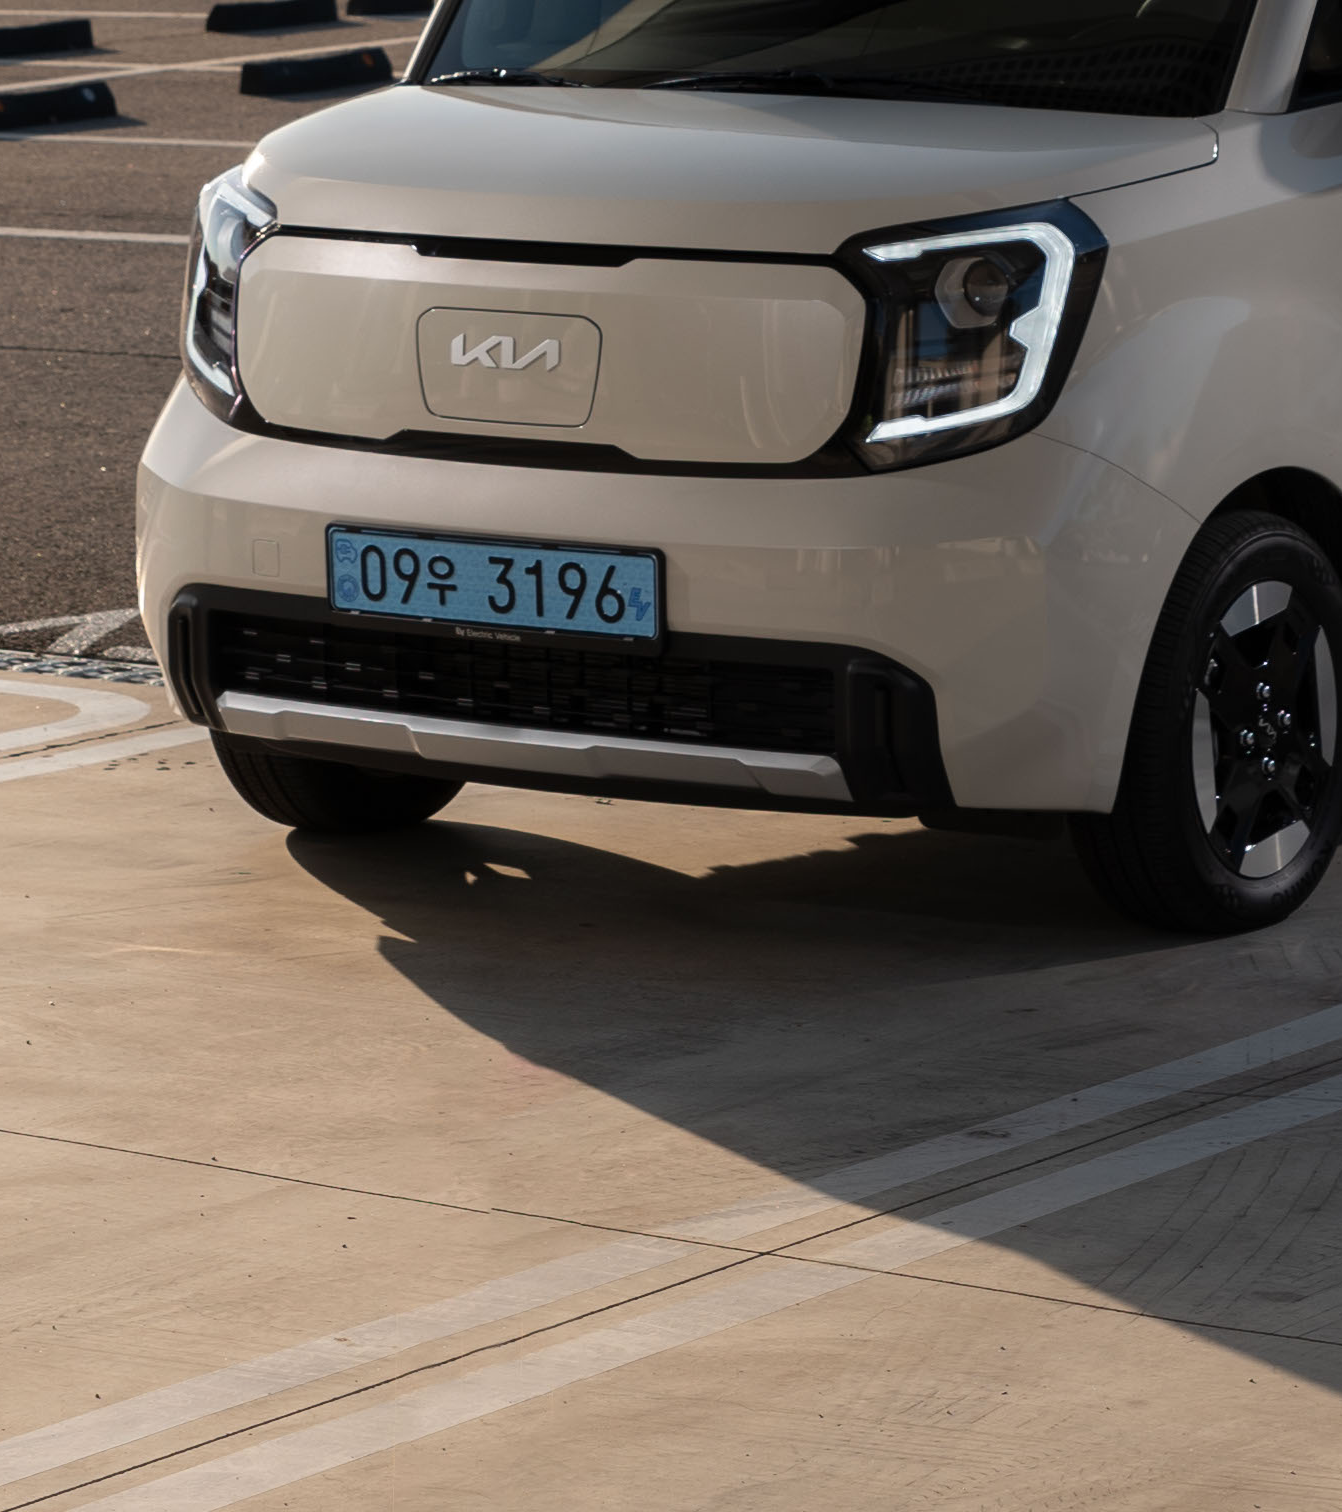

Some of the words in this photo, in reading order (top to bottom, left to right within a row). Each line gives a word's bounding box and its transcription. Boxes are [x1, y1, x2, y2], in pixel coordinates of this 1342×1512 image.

[450, 333, 561, 372] KIA
[360, 544, 457, 607] 09우
[488, 556, 626, 625] 3196
[628, 587, 652, 622] EV
[466, 627, 493, 640] Electric
[494, 631, 522, 642] Vehicle
